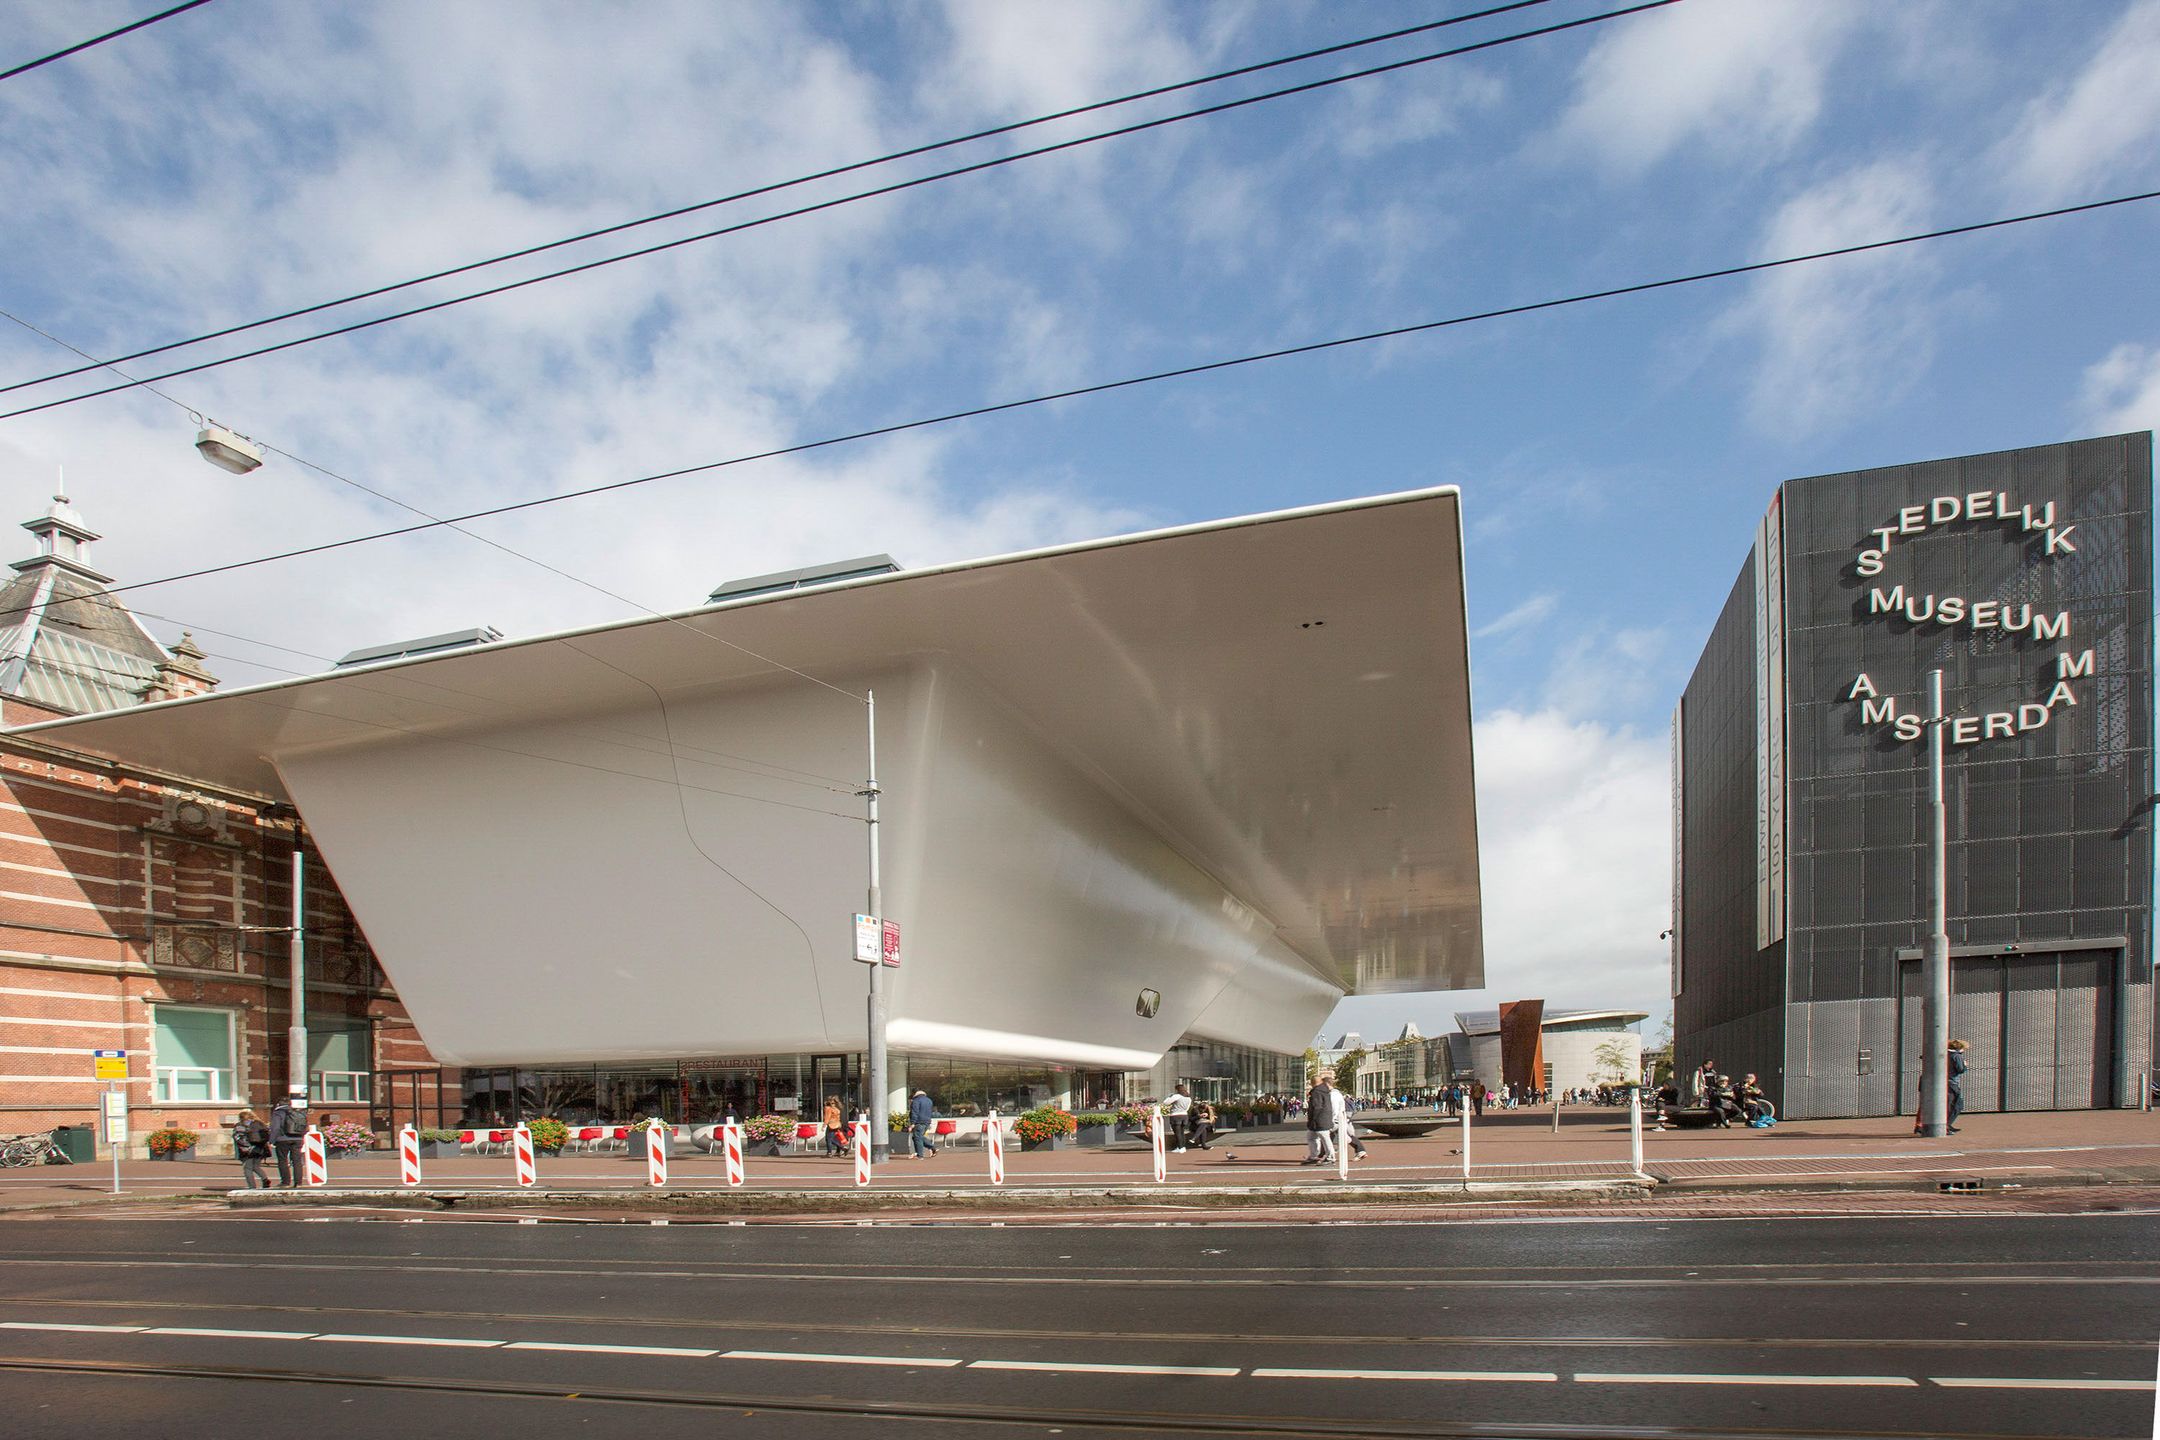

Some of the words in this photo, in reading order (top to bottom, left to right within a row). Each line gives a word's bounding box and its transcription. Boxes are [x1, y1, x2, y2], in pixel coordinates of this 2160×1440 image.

[1856, 491, 2076, 577] STEDELIJK
[1870, 585, 2070, 640] MUSEUM
[1849, 649, 2094, 744] AMSERDAM
[1772, 717, 1780, 825] YEARS
